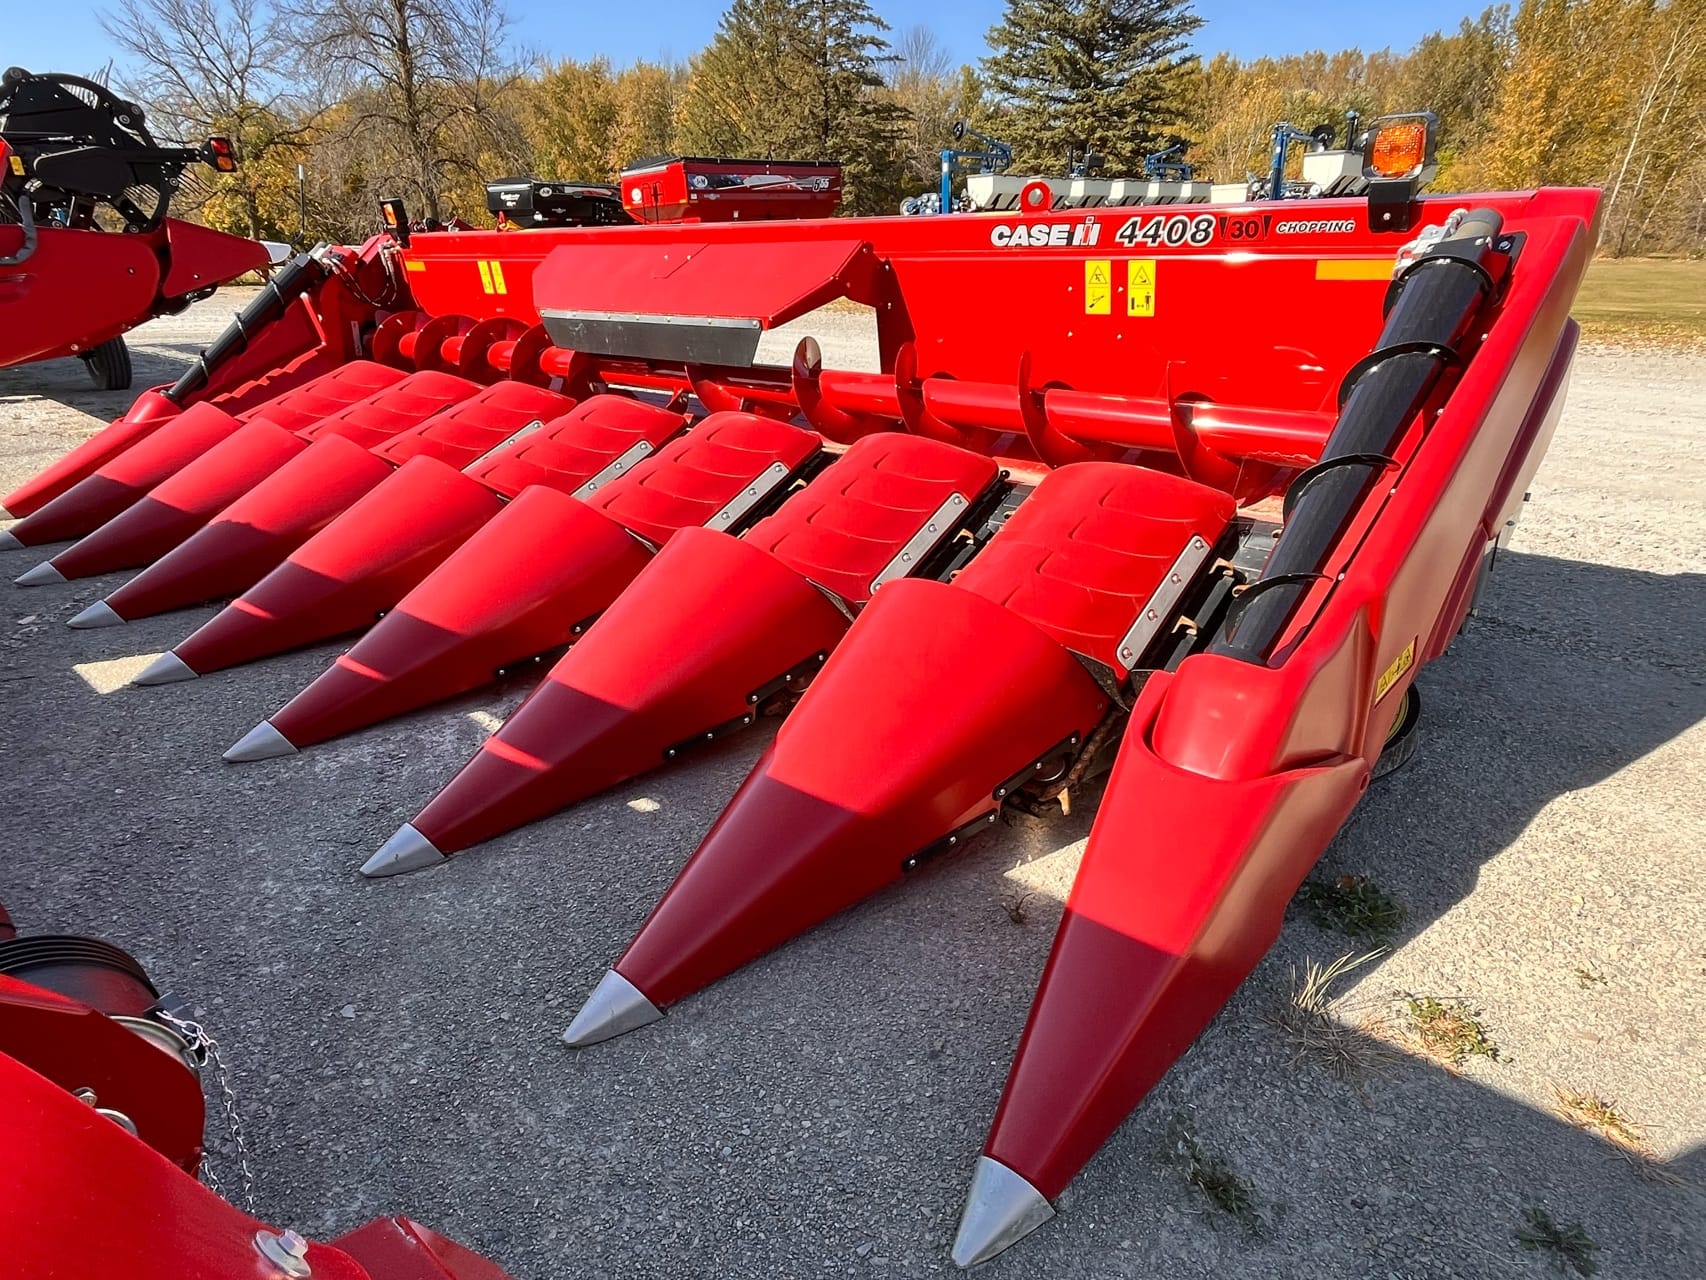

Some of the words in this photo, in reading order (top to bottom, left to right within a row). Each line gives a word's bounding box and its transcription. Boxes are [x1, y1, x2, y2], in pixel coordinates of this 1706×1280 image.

[990, 223, 1070, 247] CASE
[1115, 214, 1217, 248] 4408
[1230, 220, 1260, 240] 30
[1276, 219, 1355, 235] CHOPPING
